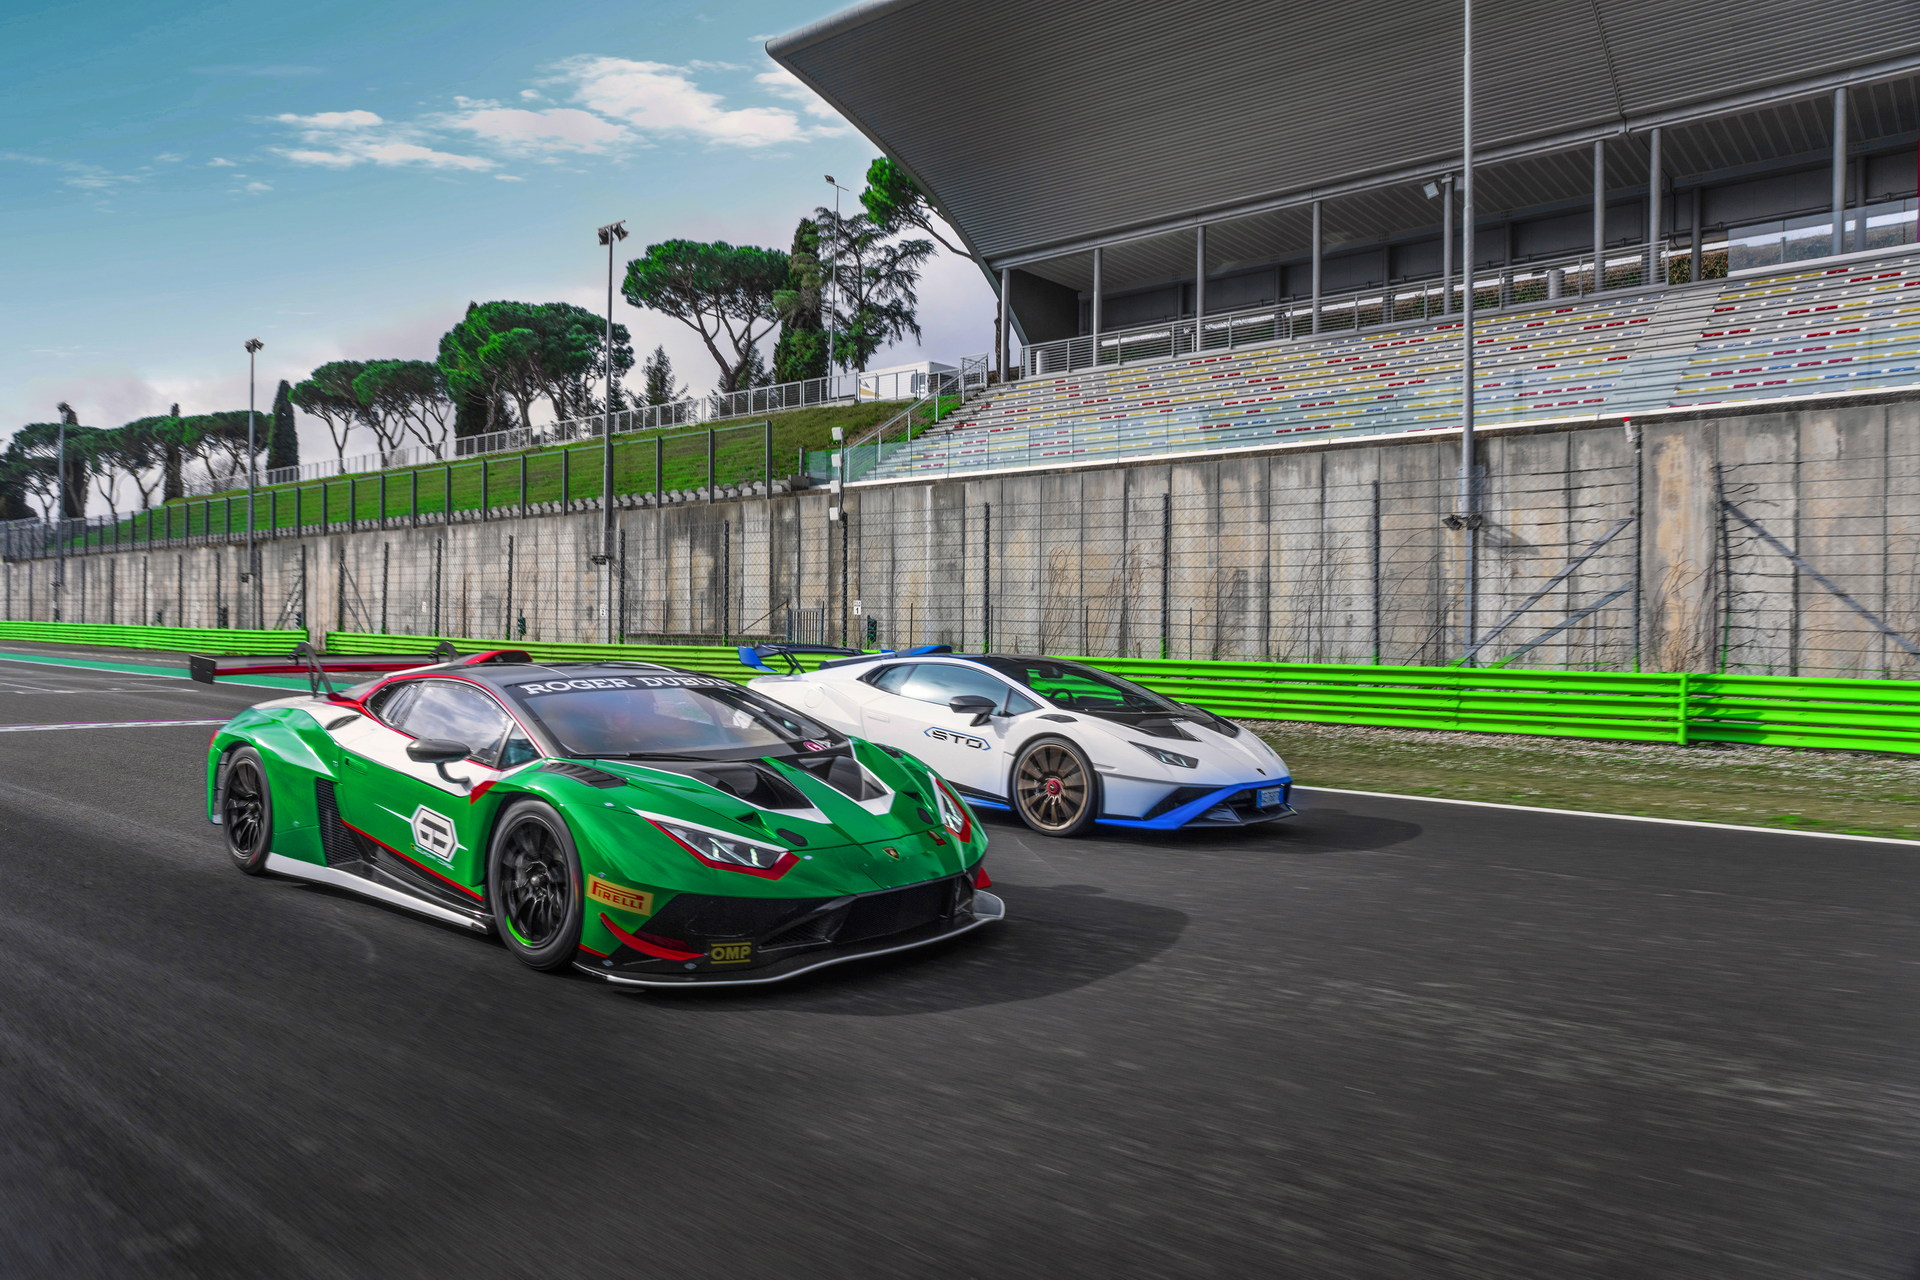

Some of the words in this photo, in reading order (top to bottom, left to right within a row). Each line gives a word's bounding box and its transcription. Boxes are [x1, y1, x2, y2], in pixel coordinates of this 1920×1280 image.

[520, 678, 636, 695] ROGER
[932, 730, 982, 749] STO
[592, 880, 645, 910] PIRELLI
[711, 945, 751, 960] OMP
